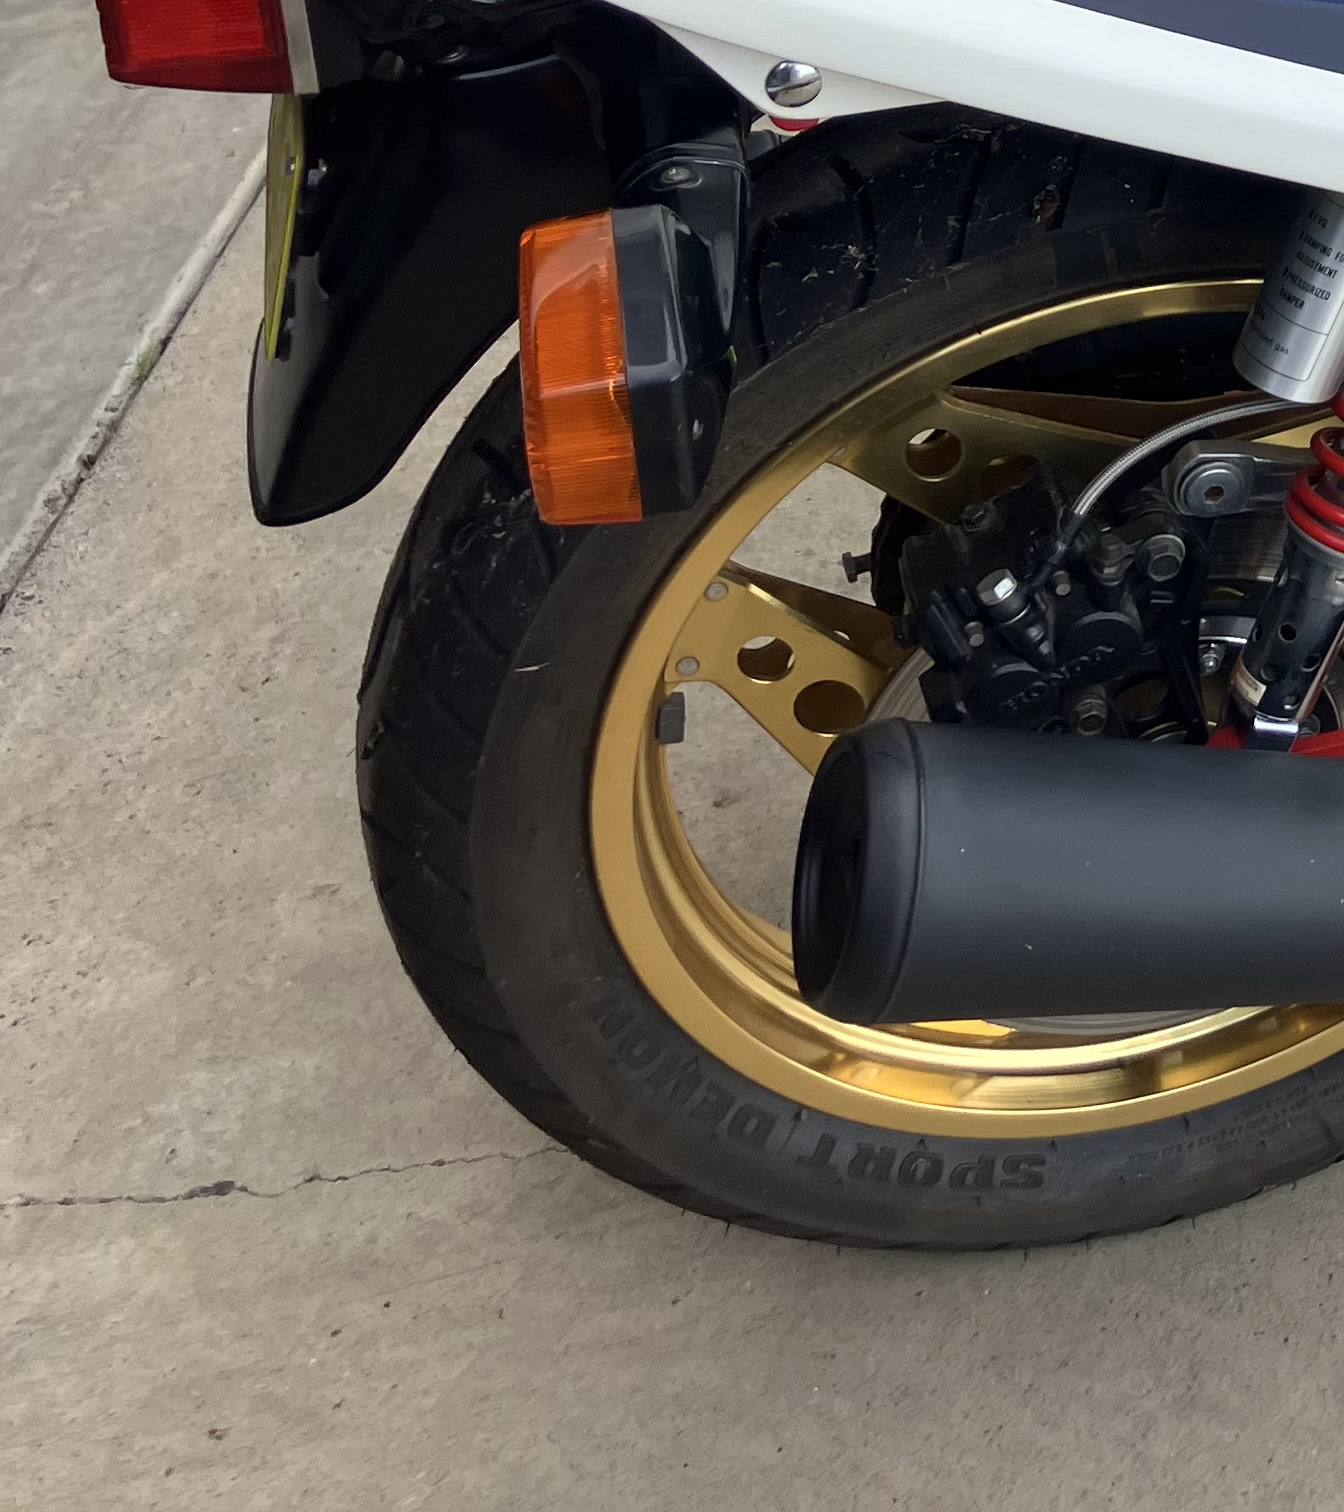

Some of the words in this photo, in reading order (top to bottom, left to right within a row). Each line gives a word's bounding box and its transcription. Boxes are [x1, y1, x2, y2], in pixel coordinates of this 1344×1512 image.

[1295, 252, 1338, 280] ADJUSTMENT
[1279, 287, 1306, 311] DAMPER
[1287, 267, 1331, 301] PRESSURIZED
[588, 998, 778, 1150] DEMON
[795, 1132, 1051, 1190] SPORT
